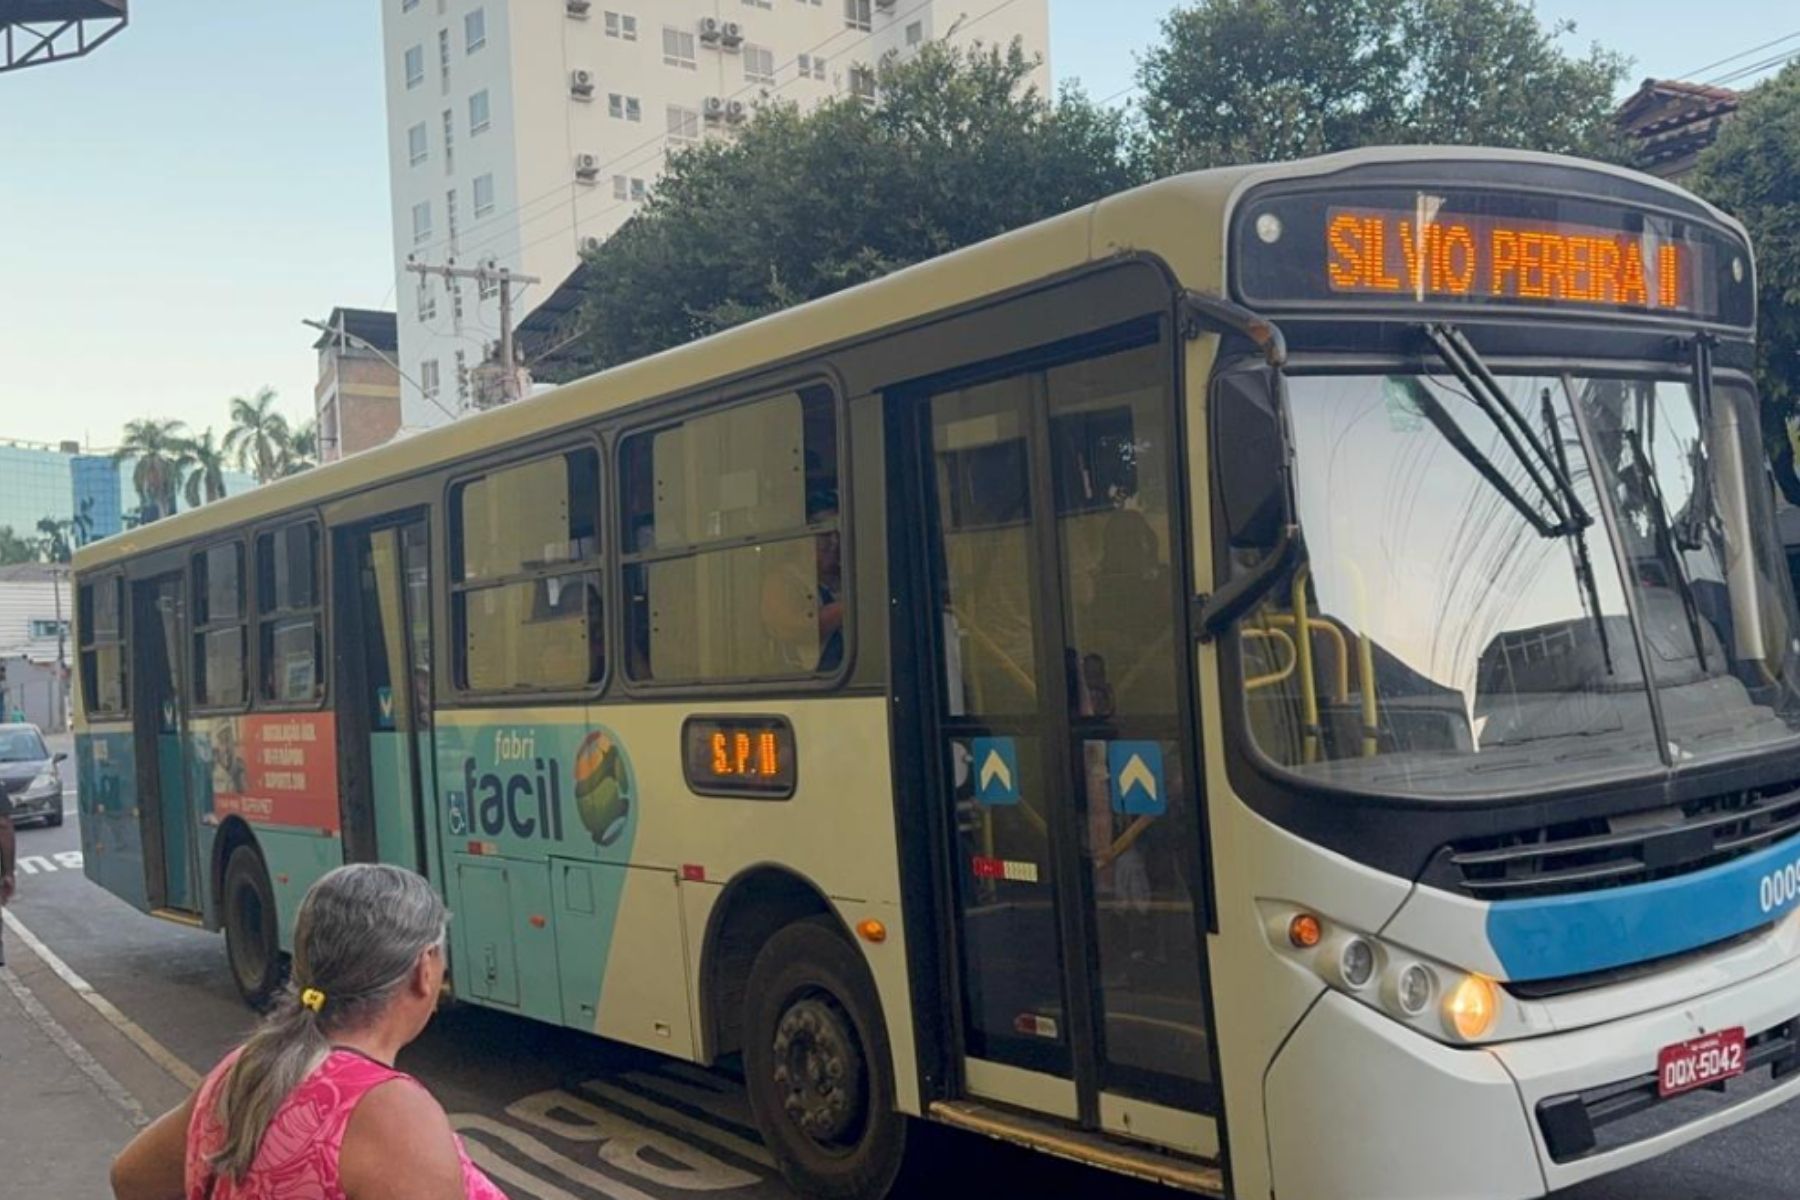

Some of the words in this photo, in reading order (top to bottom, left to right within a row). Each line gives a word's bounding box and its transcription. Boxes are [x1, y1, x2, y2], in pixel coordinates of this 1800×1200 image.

[1329, 215, 1475, 293] SILVIO
[1492, 230, 1646, 303] PEREIRA
[1658, 246, 1676, 306] II
[495, 729, 535, 766] fabri
[465, 757, 563, 841] facil
